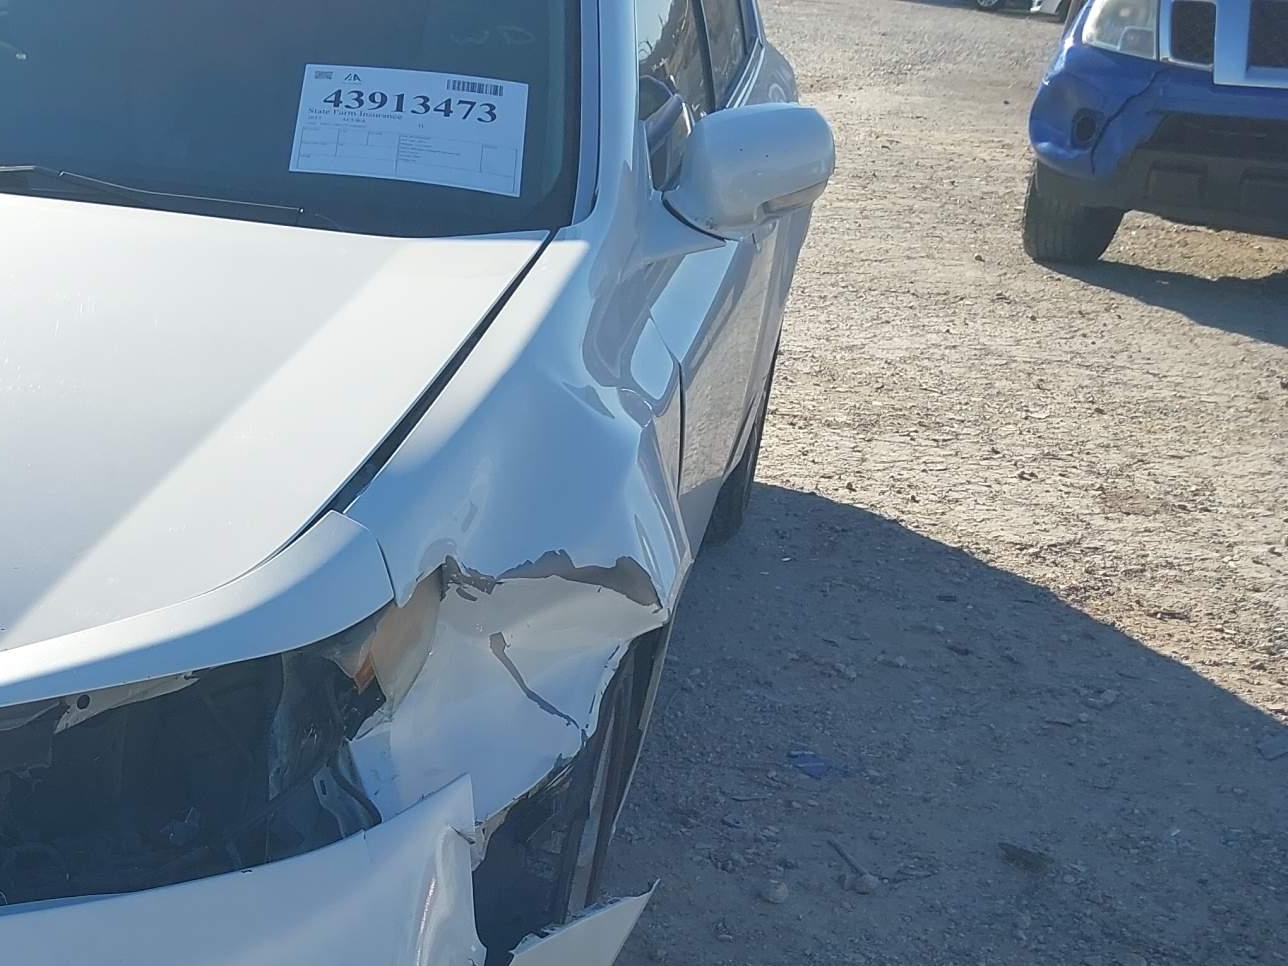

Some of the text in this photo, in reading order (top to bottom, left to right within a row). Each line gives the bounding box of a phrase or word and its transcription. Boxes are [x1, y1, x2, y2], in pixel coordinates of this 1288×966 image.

[308, 106, 330, 116] State
[333, 109, 357, 118] Farm
[360, 111, 403, 121] Insurance
[323, 88, 498, 124] 43913473
